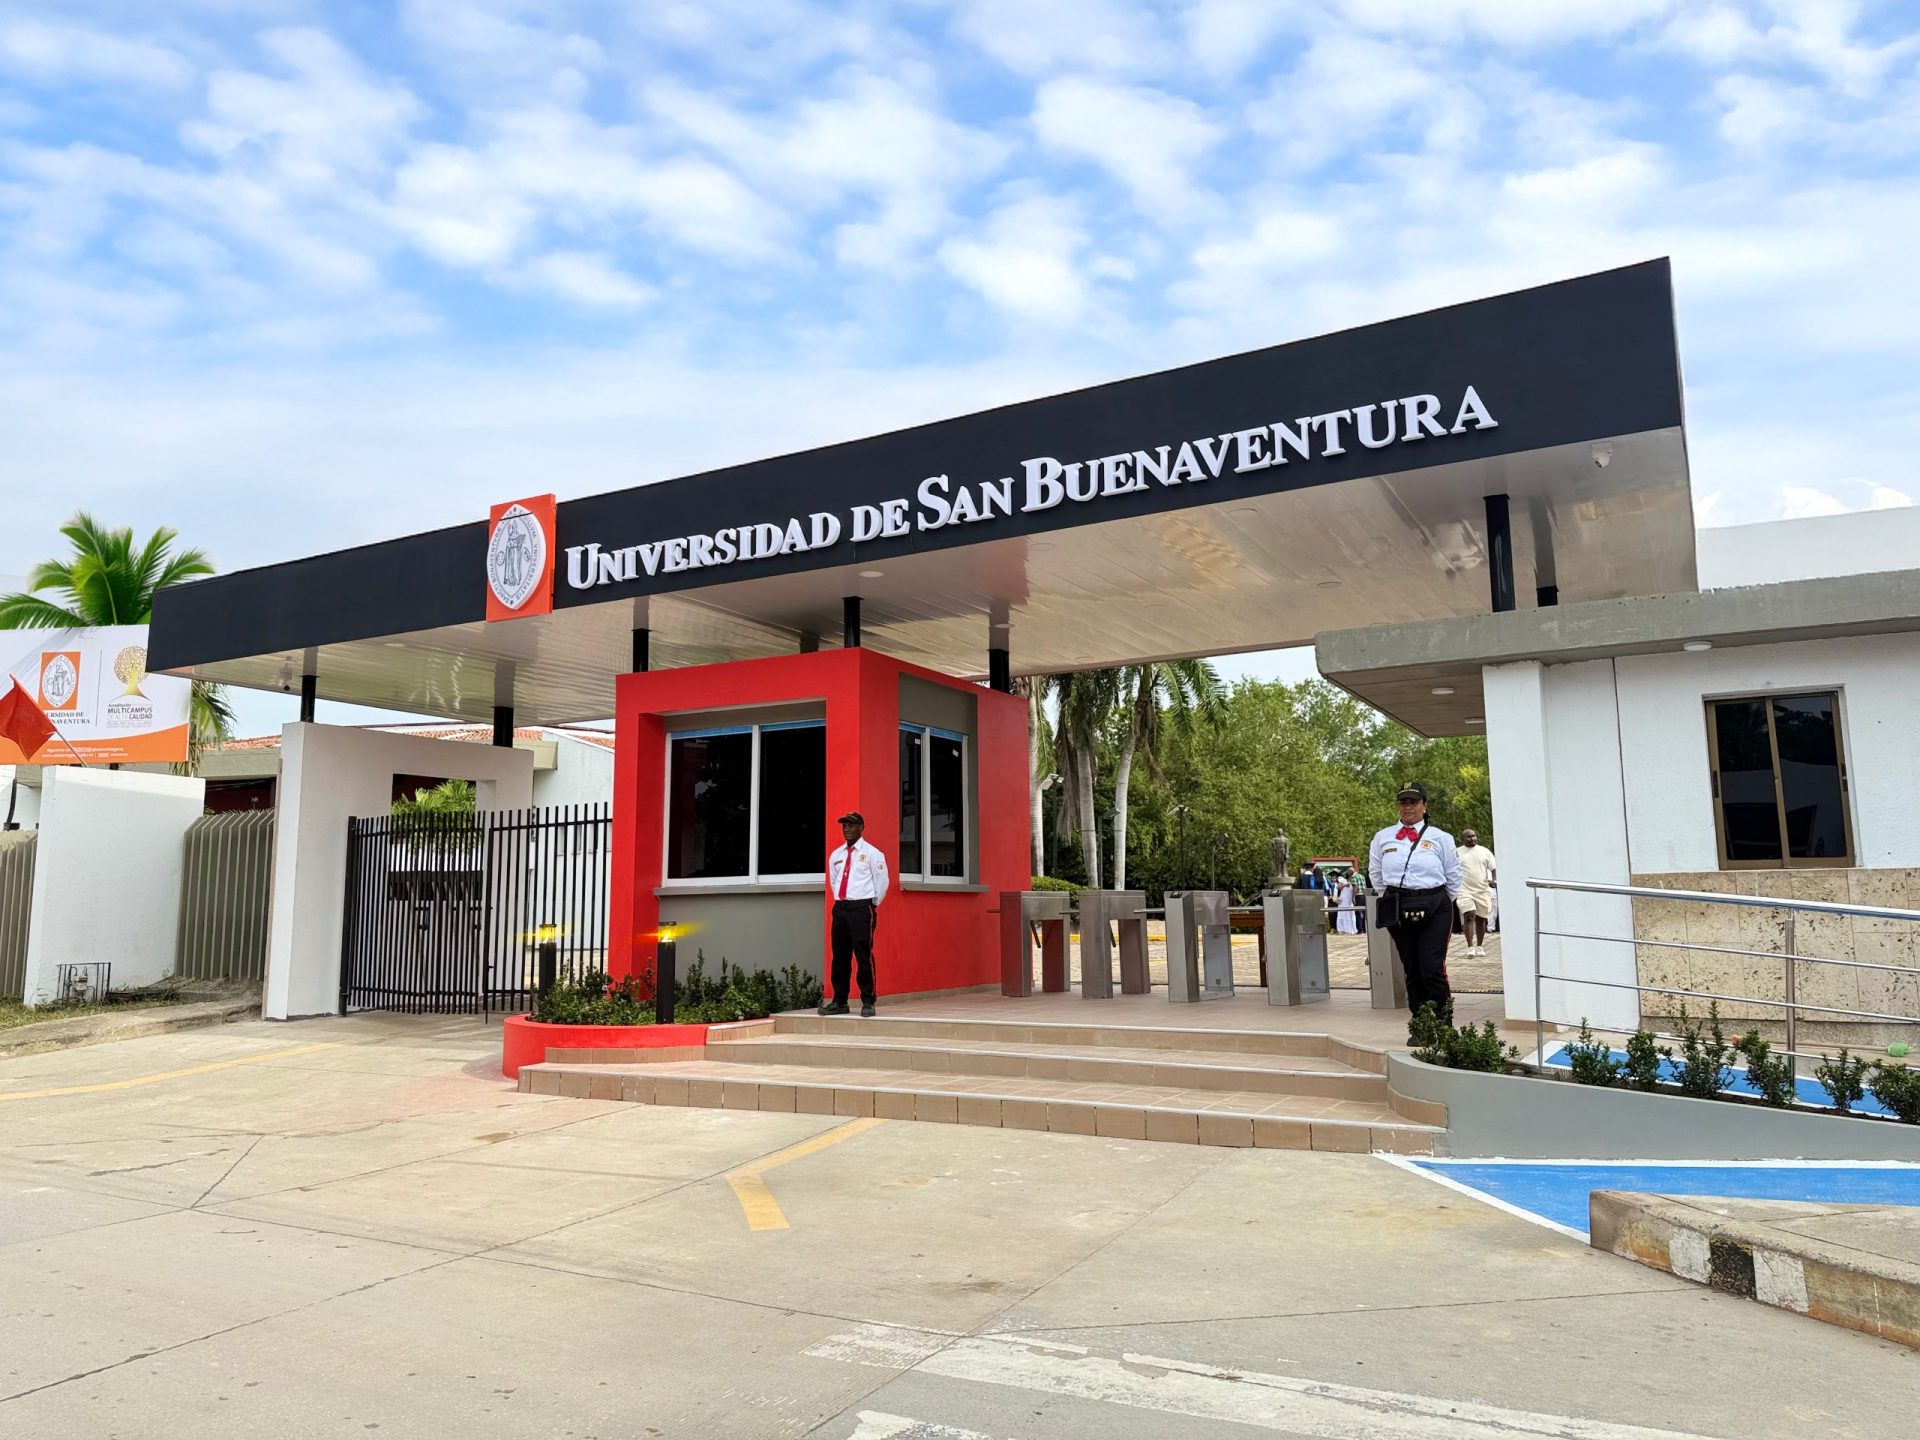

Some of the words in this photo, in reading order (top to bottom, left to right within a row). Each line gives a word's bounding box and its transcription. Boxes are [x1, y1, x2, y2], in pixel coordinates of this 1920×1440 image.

[565, 511, 841, 590] UNIVERSIDAD
[850, 498, 910, 543] DE
[916, 474, 1015, 532] SAN
[1020, 384, 1499, 513] BUENAVENTURA
[107, 706, 153, 714] MULTICAMPUS
